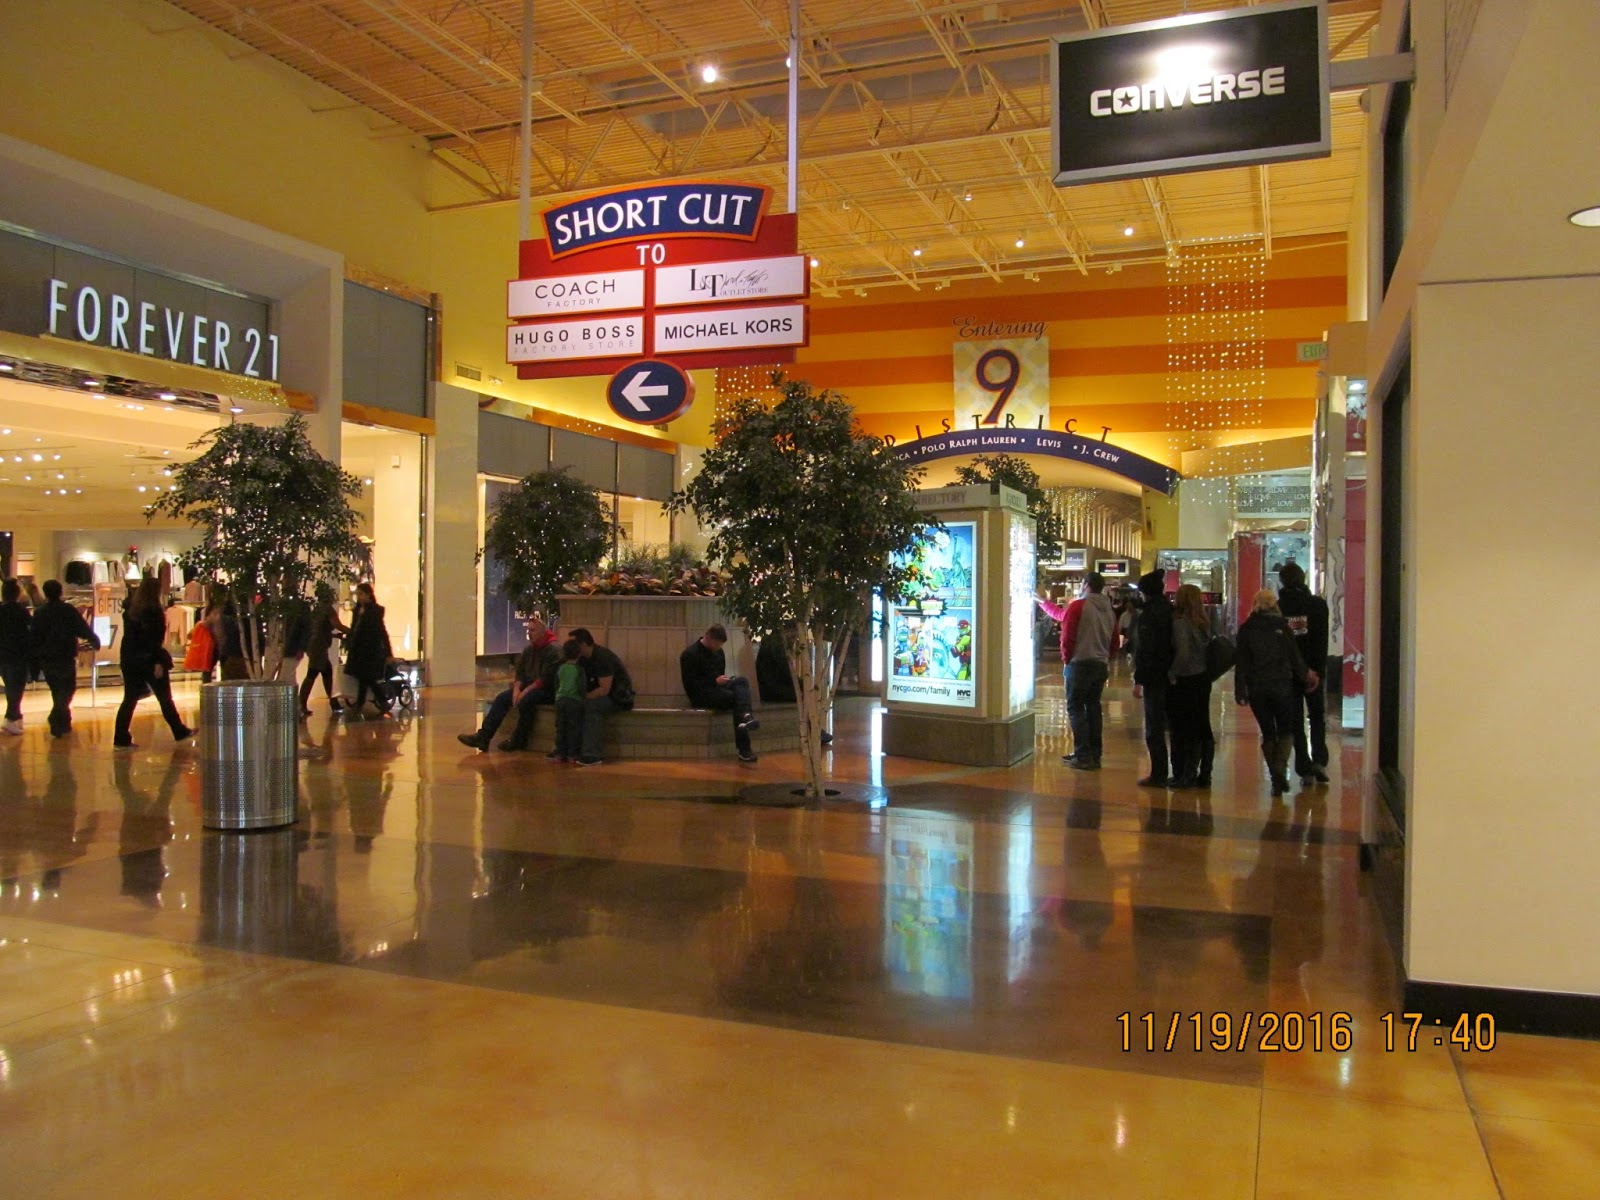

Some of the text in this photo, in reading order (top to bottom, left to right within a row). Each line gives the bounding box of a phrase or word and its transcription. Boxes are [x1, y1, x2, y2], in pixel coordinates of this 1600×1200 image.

[1090, 66, 1285, 117] CONVERSE
[555, 193, 752, 245] SHORT CUT
[636, 244, 666, 265] TO
[534, 279, 616, 299] COACH
[747, 287, 769, 295] STORE
[547, 298, 602, 308] FACTORY
[49, 279, 279, 381] FOREVER 21
[515, 324, 635, 345] HUGO BOSS
[664, 318, 793, 340] MICHAEL KORS
[953, 316, 1049, 341] Entering
[514, 340, 635, 354] FACTORY STORE
[975, 348, 1020, 425] 9
[921, 442, 946, 455] POLO
[949, 438, 978, 449] RALPH
[981, 435, 1017, 446] LAUREN
[1036, 437, 1062, 449] LEVIS
[1093, 447, 1120, 463] CREW
[892, 684, 971, 697] nycgo.com/family NYC
